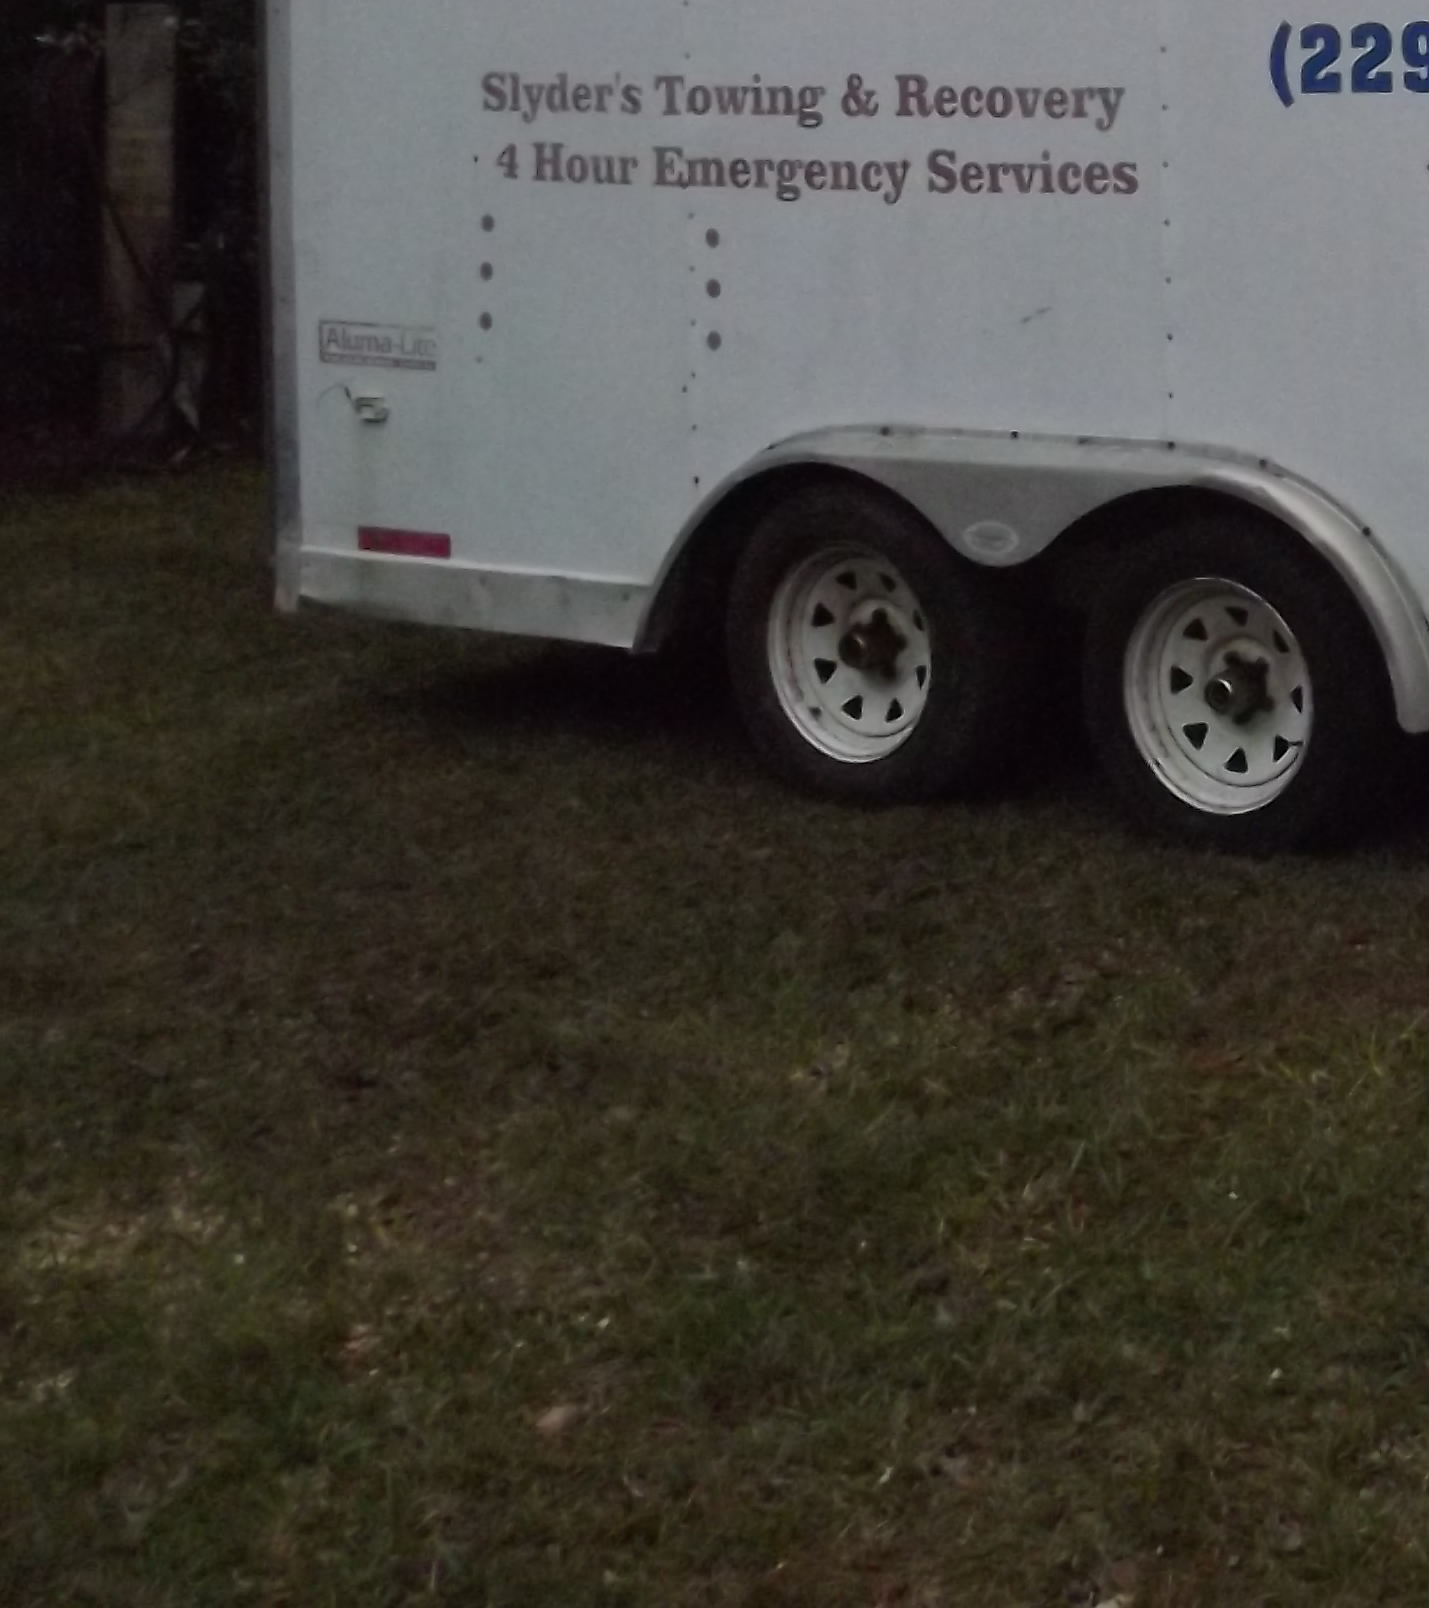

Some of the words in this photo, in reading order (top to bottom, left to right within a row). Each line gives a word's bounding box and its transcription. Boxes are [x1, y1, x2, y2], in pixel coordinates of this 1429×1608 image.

[481, 71, 642, 124] Slyder's
[654, 74, 827, 129] Towing
[840, 74, 879, 118] &
[894, 74, 1126, 131] Recovery
[495, 143, 520, 180] 4
[532, 142, 638, 186] Hour
[653, 146, 911, 204] Emergency
[926, 149, 1140, 195] Services
